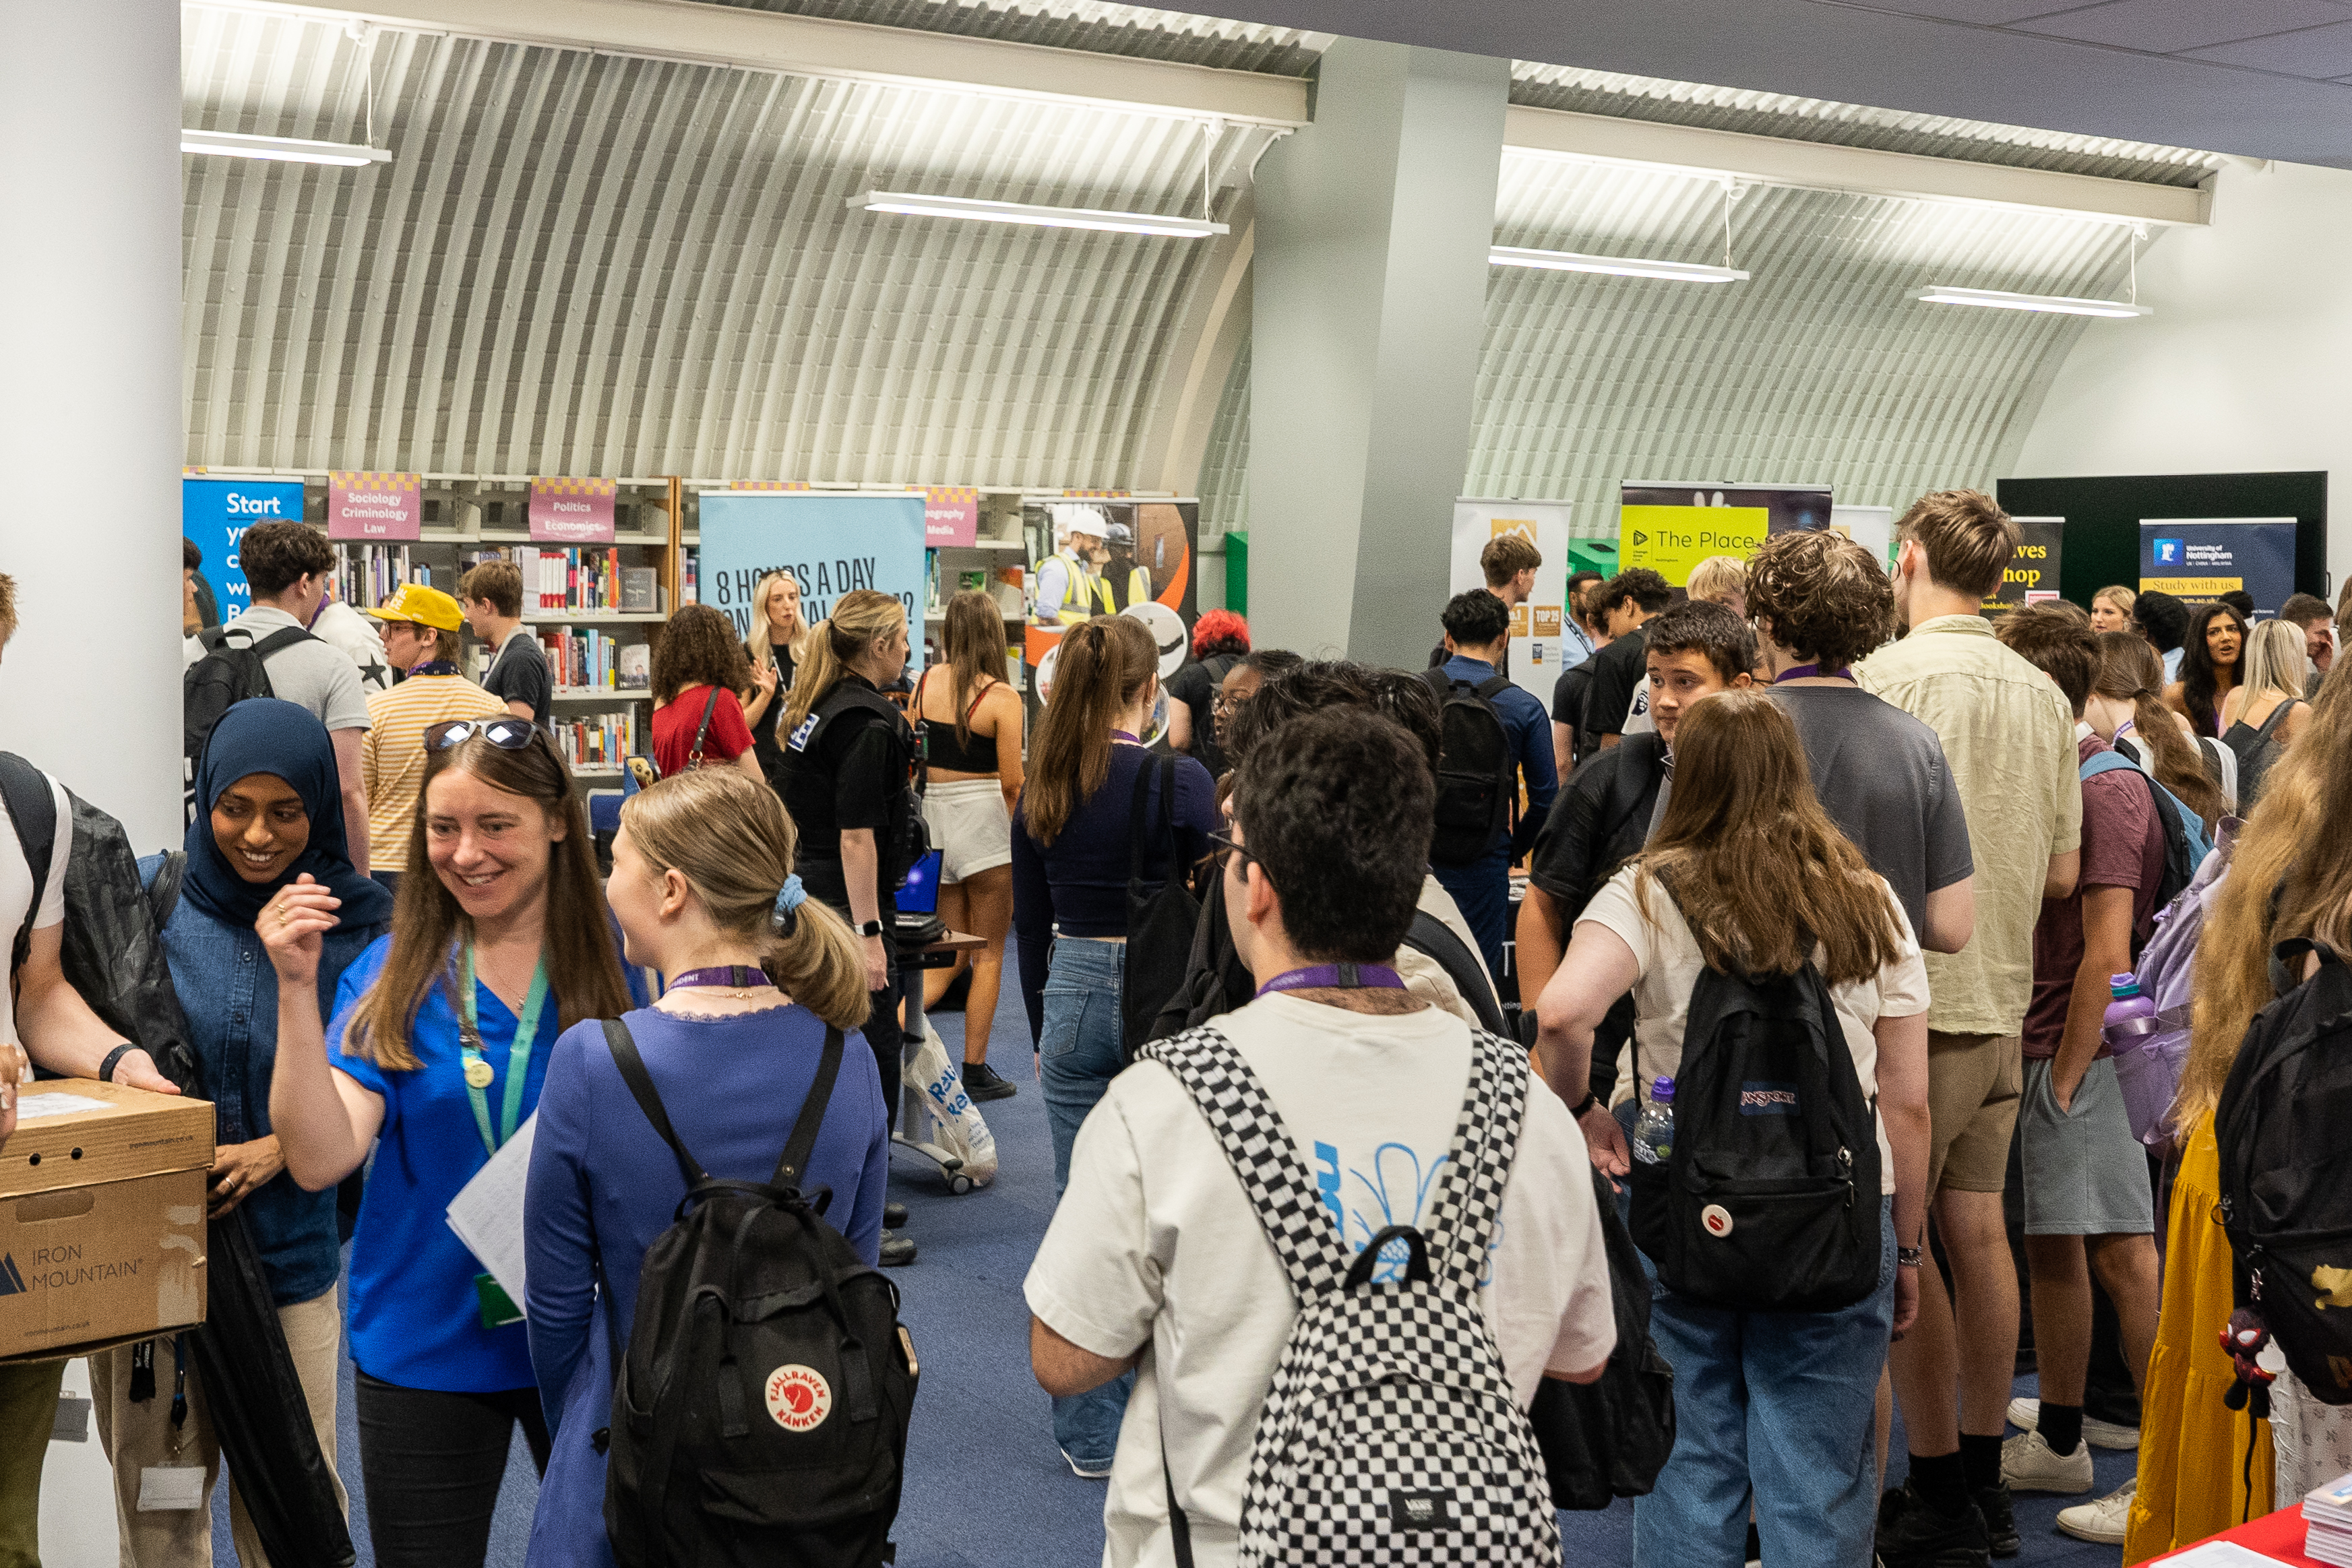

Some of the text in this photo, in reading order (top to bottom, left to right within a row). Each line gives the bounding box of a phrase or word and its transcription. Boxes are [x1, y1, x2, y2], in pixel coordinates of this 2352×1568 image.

[226, 493, 281, 515] Start
[348, 492, 402, 507] Sociology
[553, 501, 592, 513] Politics
[341, 507, 408, 522] Criminology
[925, 509, 965, 521] eography
[363, 522, 387, 534] Law
[545, 521, 601, 533] Economics
[927, 524, 956, 536] Media
[1657, 530, 1755, 548] The Place
[2013, 544, 2047, 559] ves
[2186, 544, 2215, 553] University
[2186, 552, 2233, 561] Nottingham
[716, 571, 731, 605] 8
[817, 561, 832, 596] A
[836, 557, 875, 594] DAY
[2003, 567, 2041, 588] hop
[2153, 579, 2237, 592] Study with us.
[1536, 610, 1550, 623] TOP
[669, 973, 700, 990] UDENT
[32, 1244, 82, 1266] IRON
